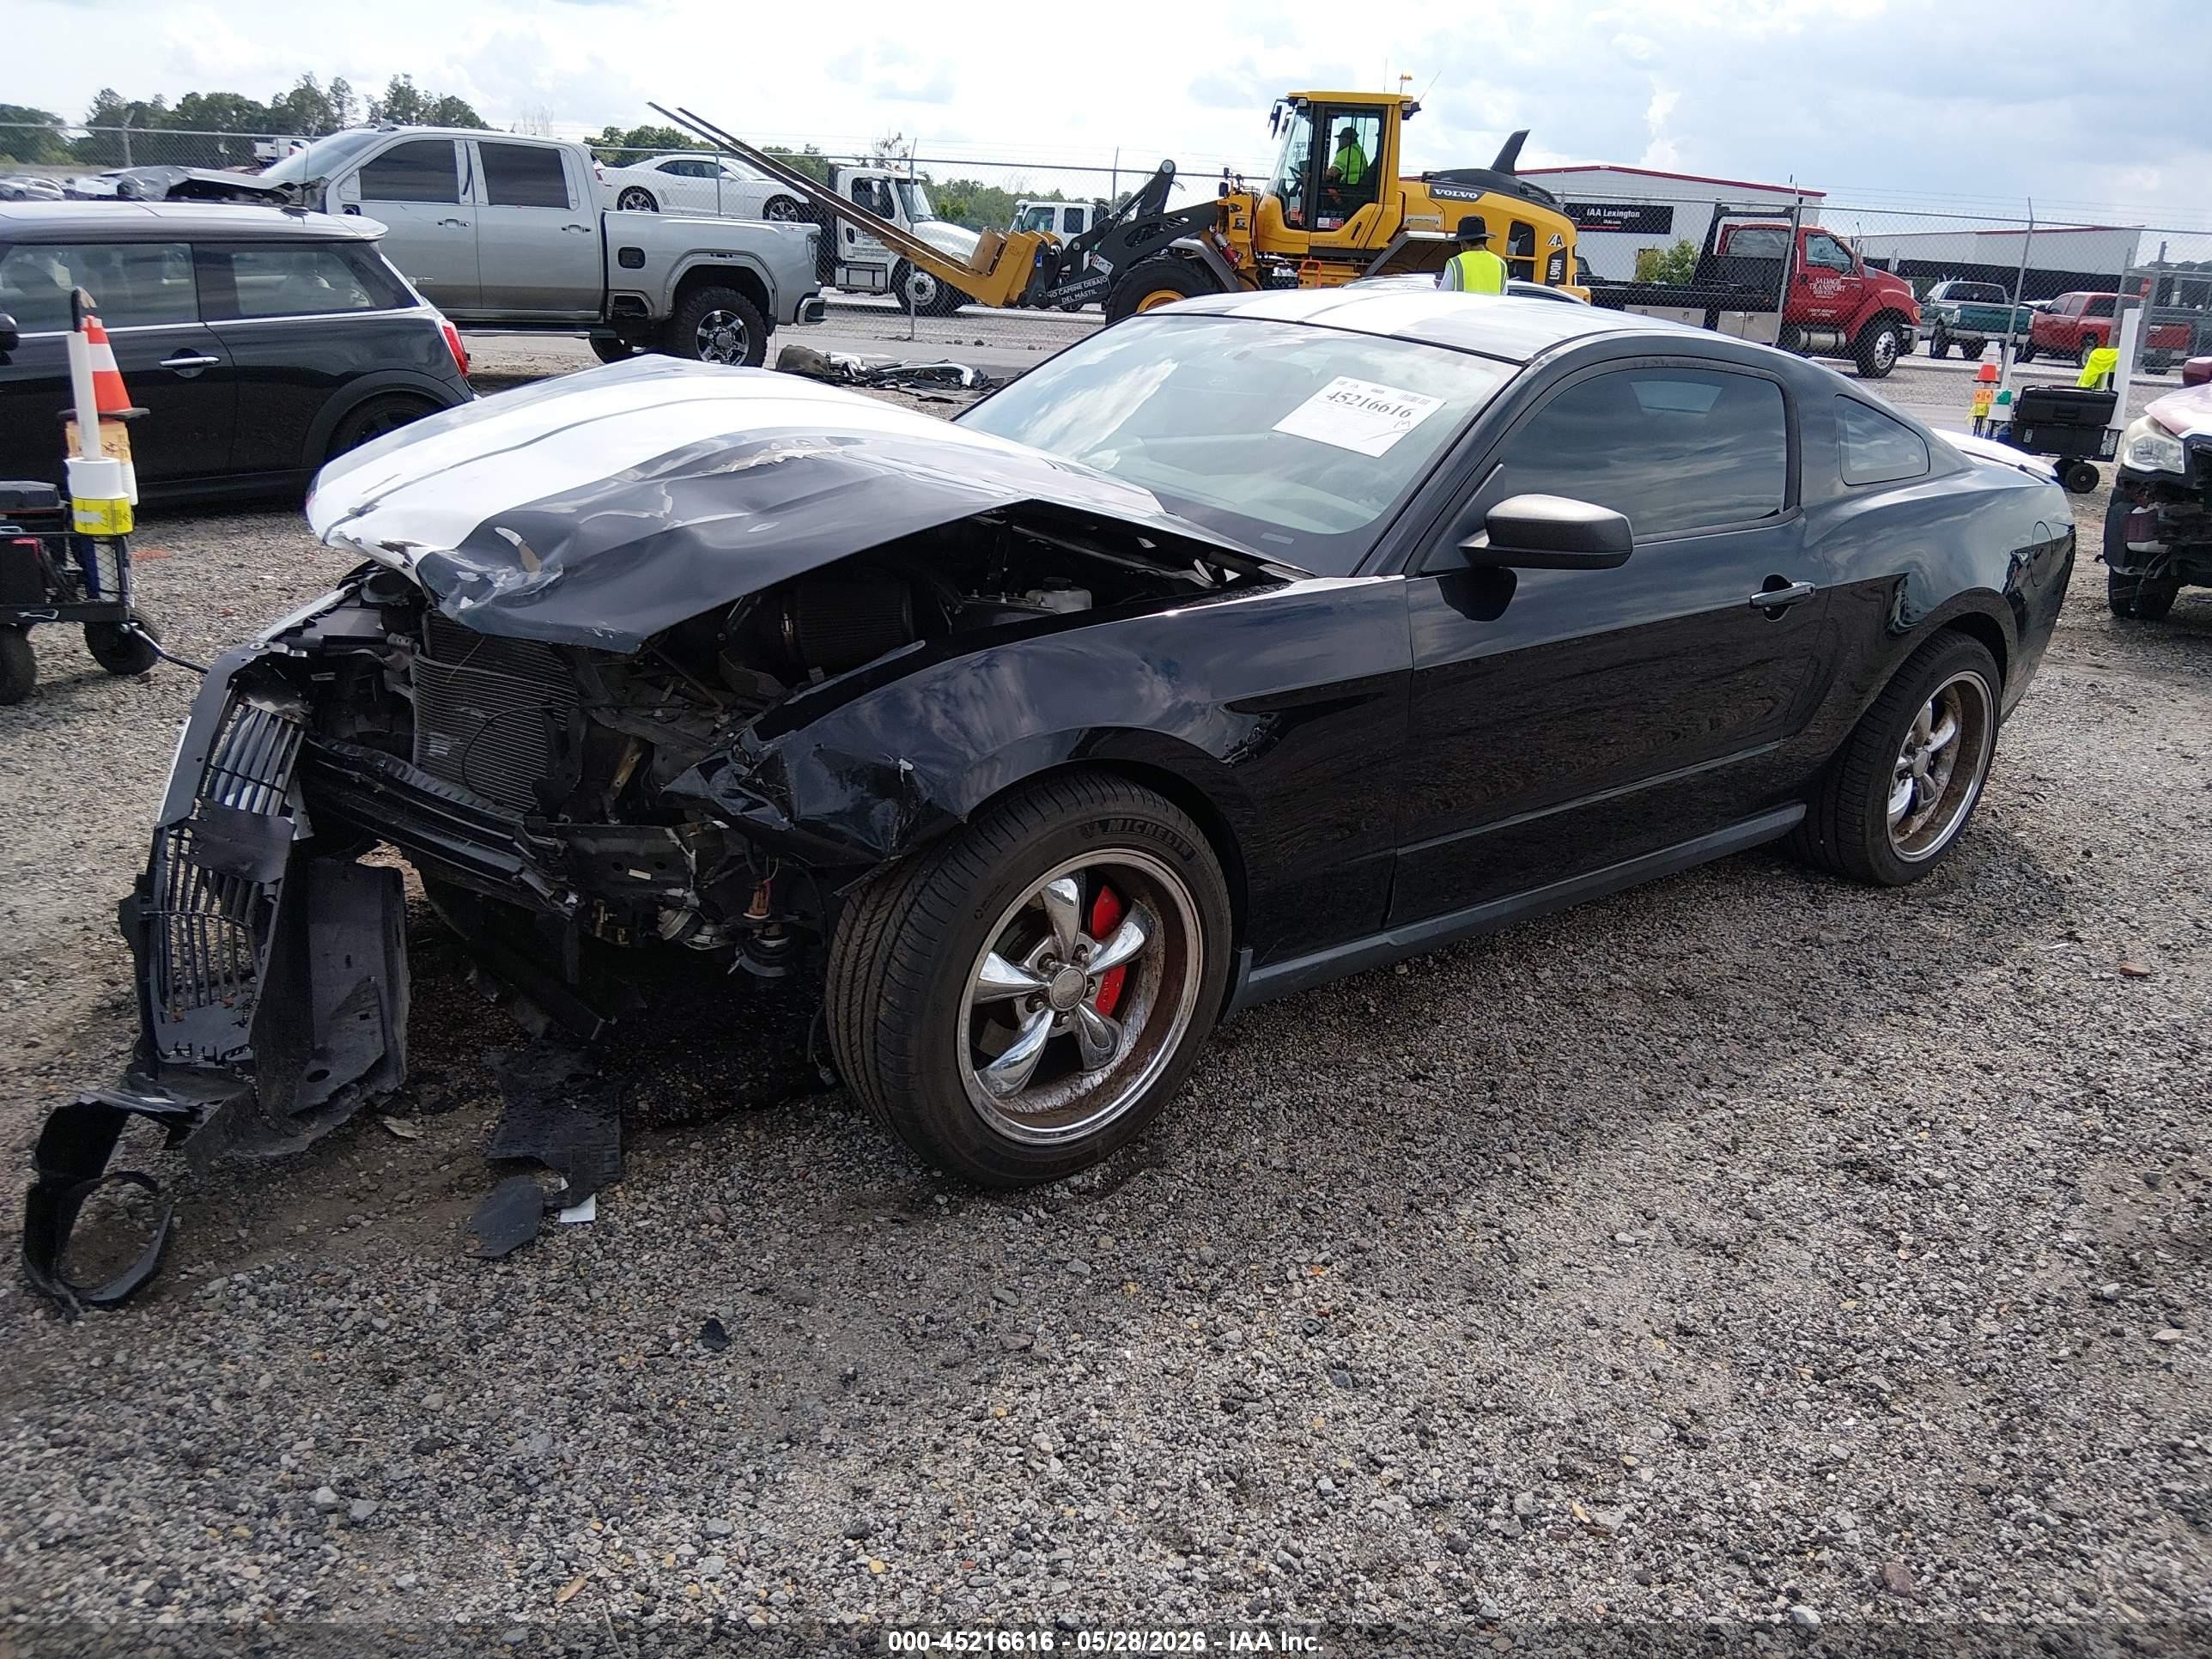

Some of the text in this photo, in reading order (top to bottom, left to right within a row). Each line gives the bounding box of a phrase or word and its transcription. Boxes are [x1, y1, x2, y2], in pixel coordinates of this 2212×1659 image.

[1433, 188, 1478, 199] VOLVO
[1586, 208, 1640, 219] IAA Lexington
[1548, 258, 1563, 281] L90H
[1059, 284, 1083, 295] CAMINE
[1084, 276, 1108, 288] DEBAJO
[1808, 283, 1846, 292] TRANSPORT
[1326, 391, 1416, 418] 45216616
[1107, 818, 1196, 860] MICHELIN
